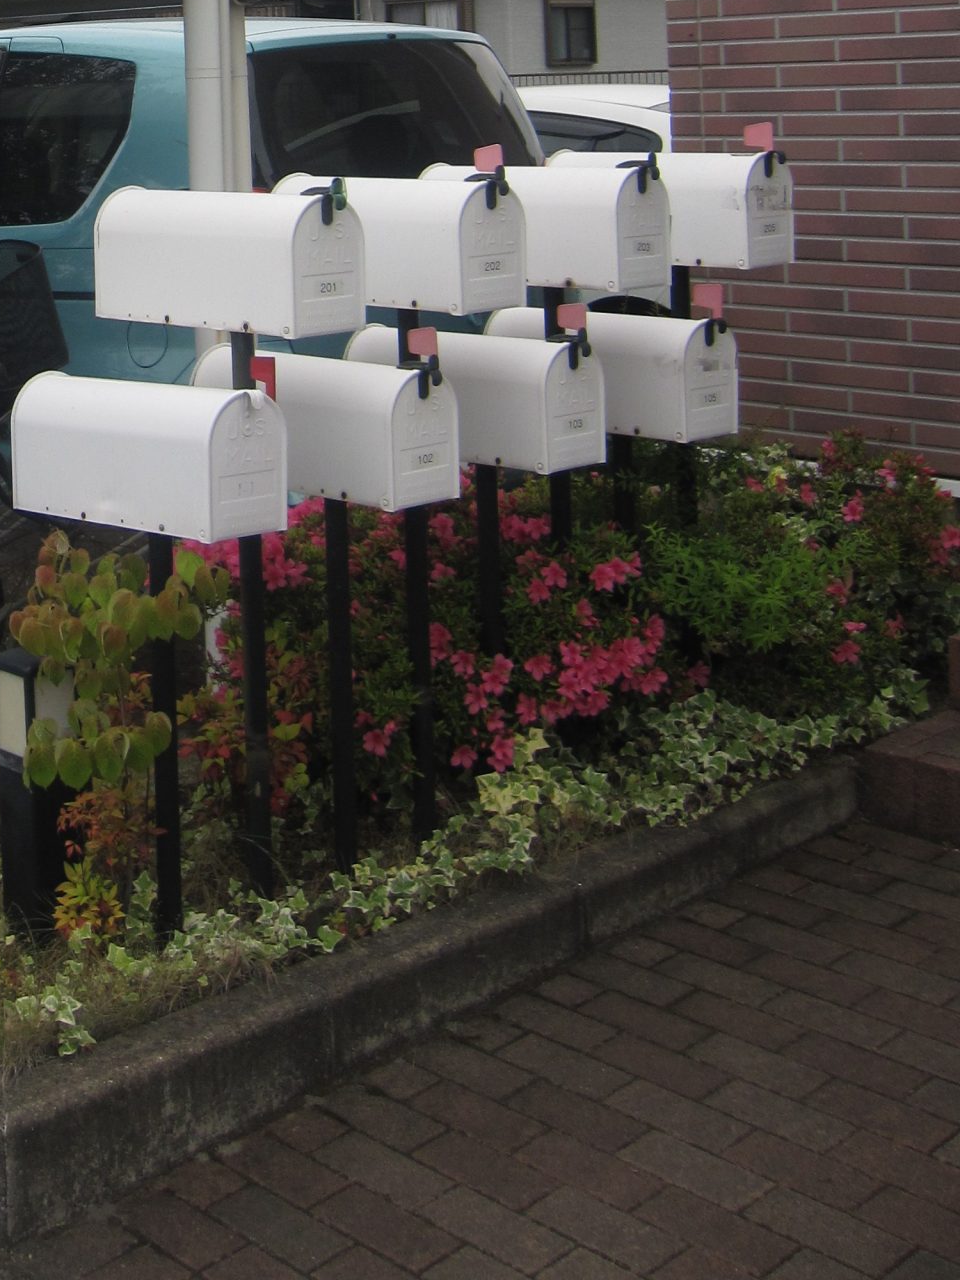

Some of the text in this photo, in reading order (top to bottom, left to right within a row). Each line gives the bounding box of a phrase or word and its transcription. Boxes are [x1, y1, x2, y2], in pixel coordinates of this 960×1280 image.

[636, 242, 651, 252] 203
[484, 261, 501, 272] 202
[320, 282, 337, 293] 201
[568, 418, 584, 429] 103
[418, 453, 434, 465] 102
